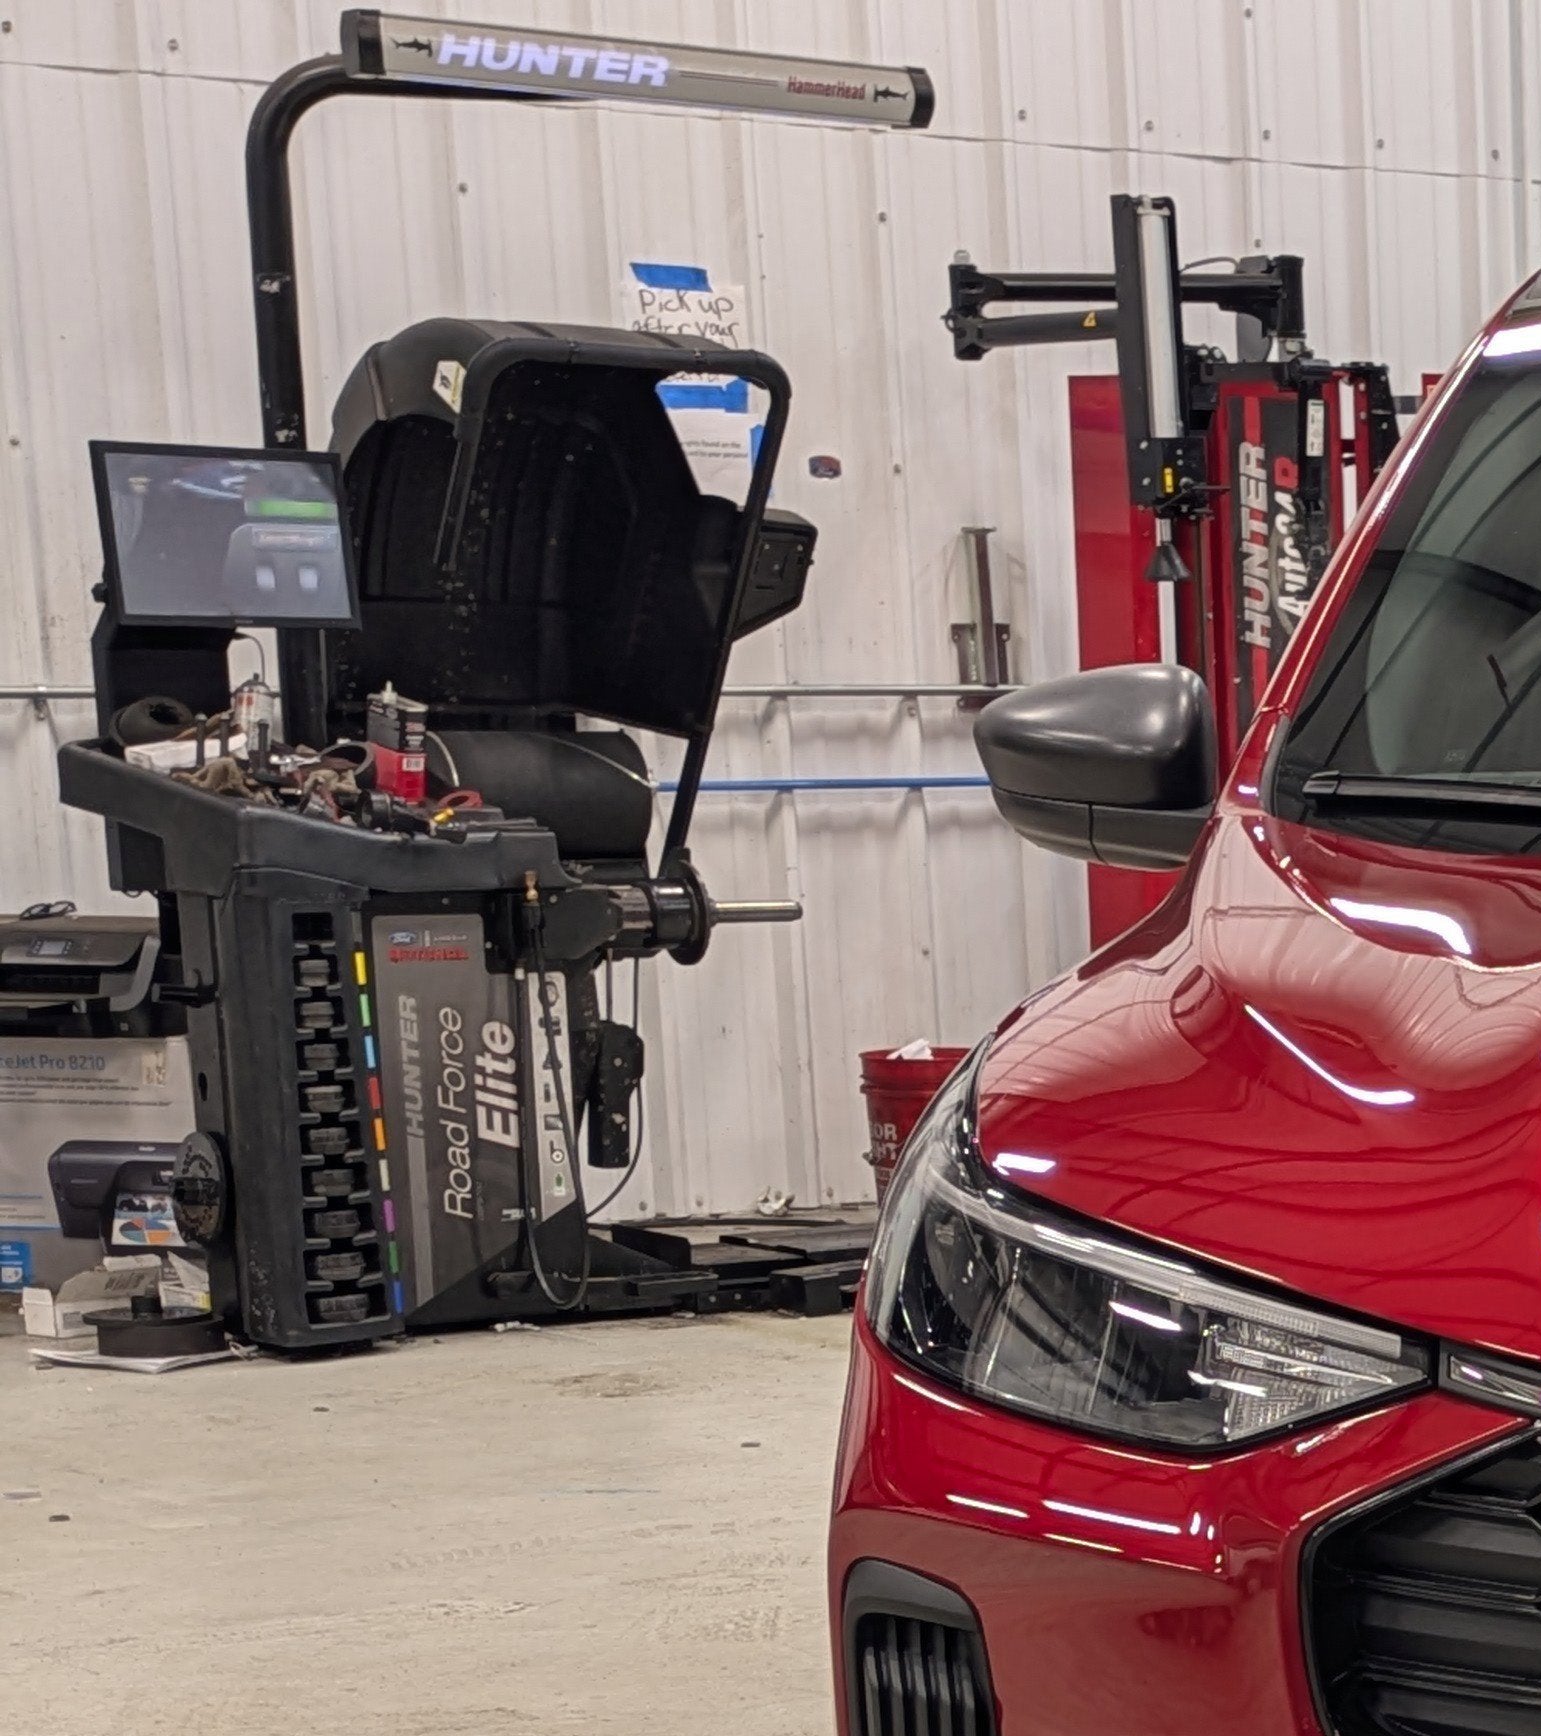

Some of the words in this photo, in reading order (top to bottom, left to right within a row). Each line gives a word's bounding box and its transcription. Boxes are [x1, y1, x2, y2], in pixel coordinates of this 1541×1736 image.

[437, 34, 668, 88] HUNTER
[787, 76, 867, 100] HammerHead
[638, 288, 692, 314] Pick
[699, 296, 734, 321] up
[1239, 441, 1271, 648] HUNTER
[39, 1054, 65, 1070] Pro
[68, 1055, 106, 1071] 8210
[398, 994, 425, 1138] HUNTER
[436, 1005, 467, 1114] Force
[473, 1021, 520, 1148] Elite
[438, 1119, 474, 1219] Road
